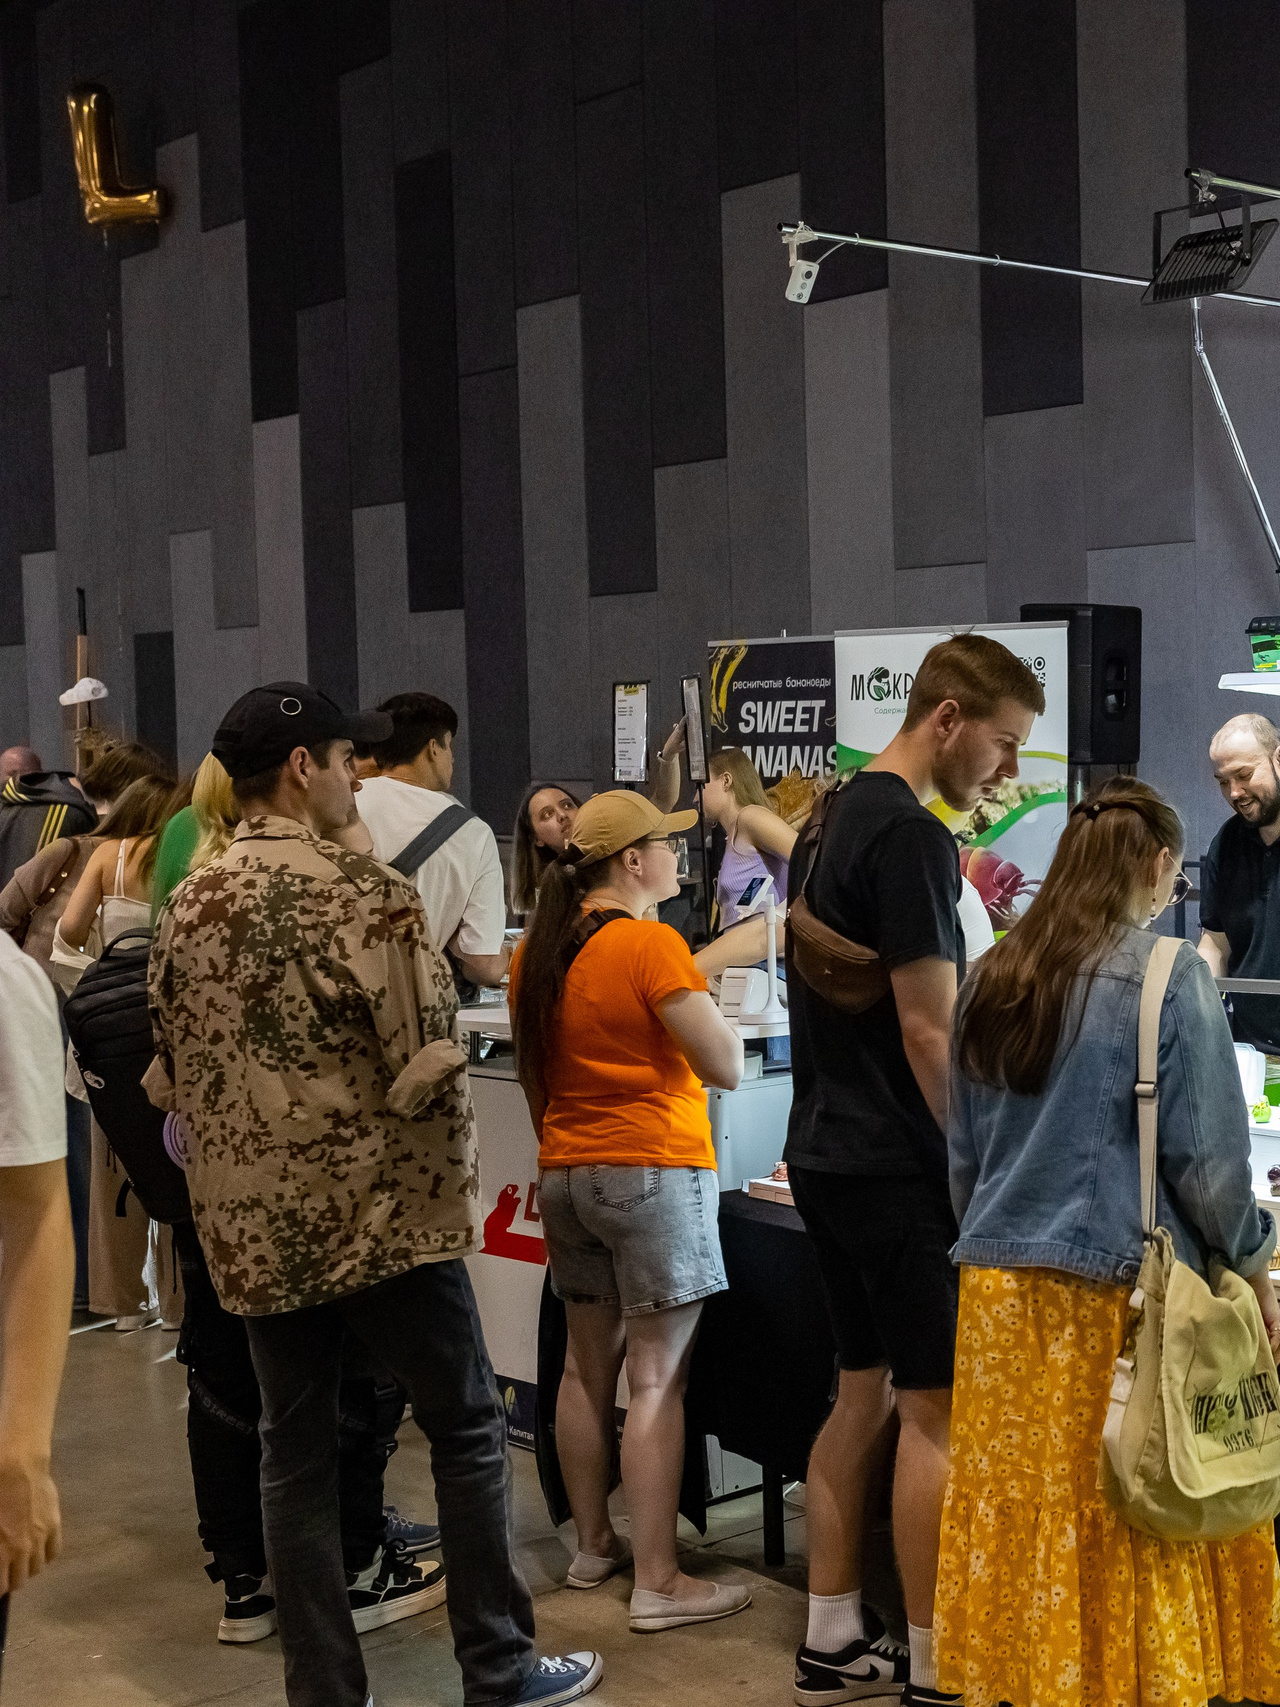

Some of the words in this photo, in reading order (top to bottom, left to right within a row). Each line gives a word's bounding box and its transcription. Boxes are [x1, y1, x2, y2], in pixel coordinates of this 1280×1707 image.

[785, 676, 832, 689] бананоеды
[738, 700, 826, 734] SWEET
[722, 745, 837, 778] NANAS
